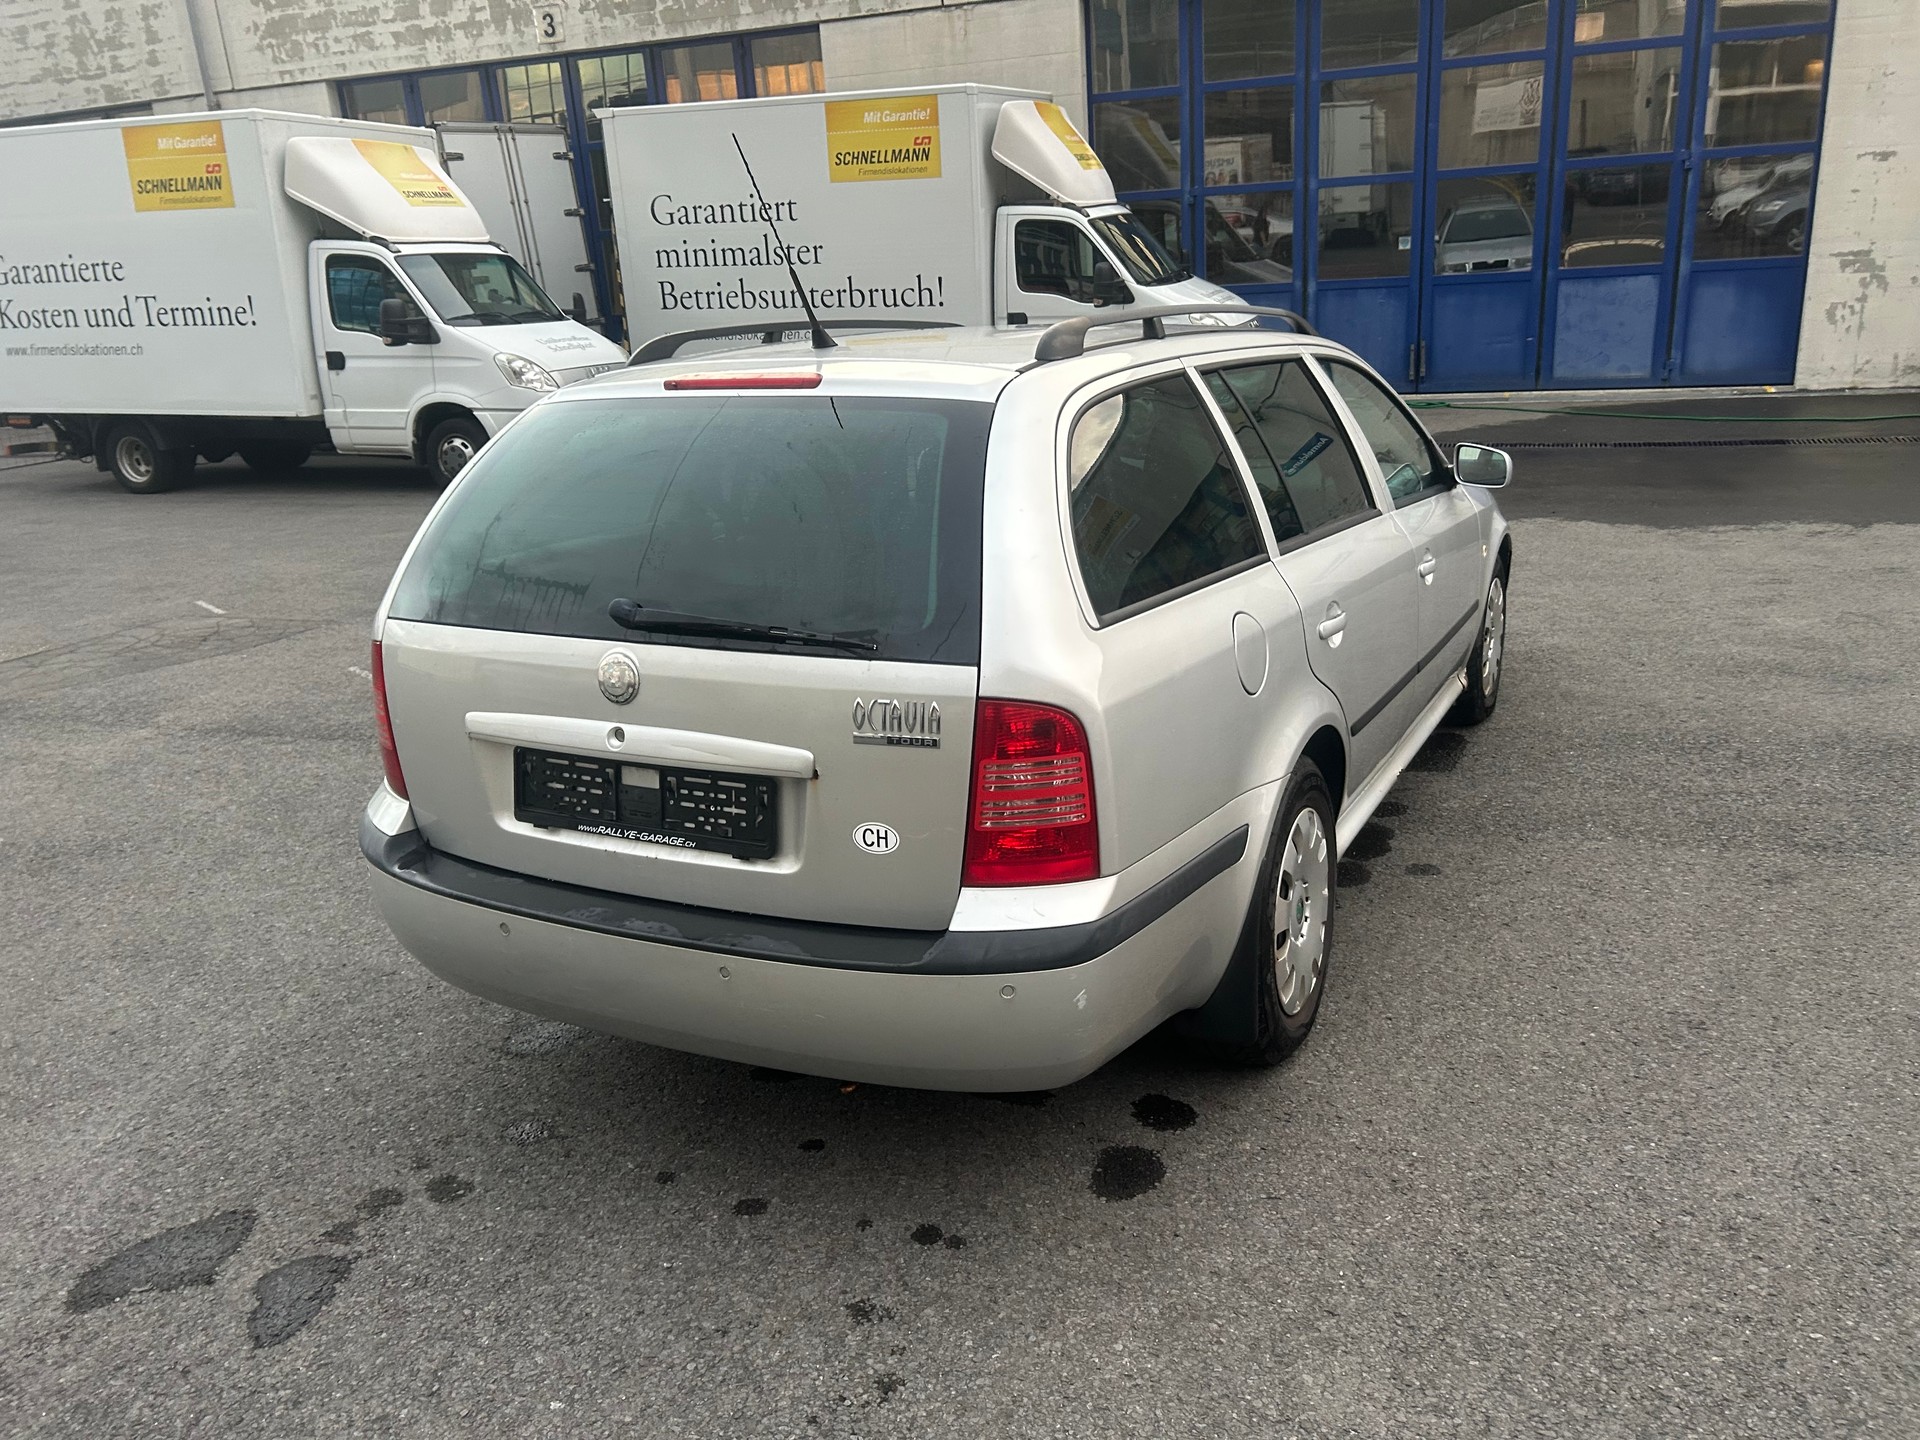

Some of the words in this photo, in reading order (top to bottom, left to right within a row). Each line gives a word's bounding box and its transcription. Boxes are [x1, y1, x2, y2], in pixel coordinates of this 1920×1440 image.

[542, 13, 556, 38] 3
[863, 111, 881, 123] Mit
[882, 108, 931, 122] Garantie!
[157, 137, 174, 150] Mit
[174, 134, 217, 149] Garantie!
[834, 147, 931, 166] SCHNELLMANN
[858, 166, 928, 176] Firmendislokationen
[136, 175, 222, 195] SCHNELLMANN
[402, 190, 454, 199] SCHNELLMANN
[650, 193, 799, 226] Garantiert
[655, 233, 824, 268] minimalster
[658, 274, 945, 311] Betriebsunterbruch!
[0, 299, 80, 329] Kosten
[84, 295, 135, 328] und
[135, 295, 257, 327] Termine!
[6, 343, 144, 357] www.firmendislokationen.ch
[852, 696, 941, 735] OCTAVIA
[891, 737, 934, 747] TOUR
[862, 827, 889, 849] CH
